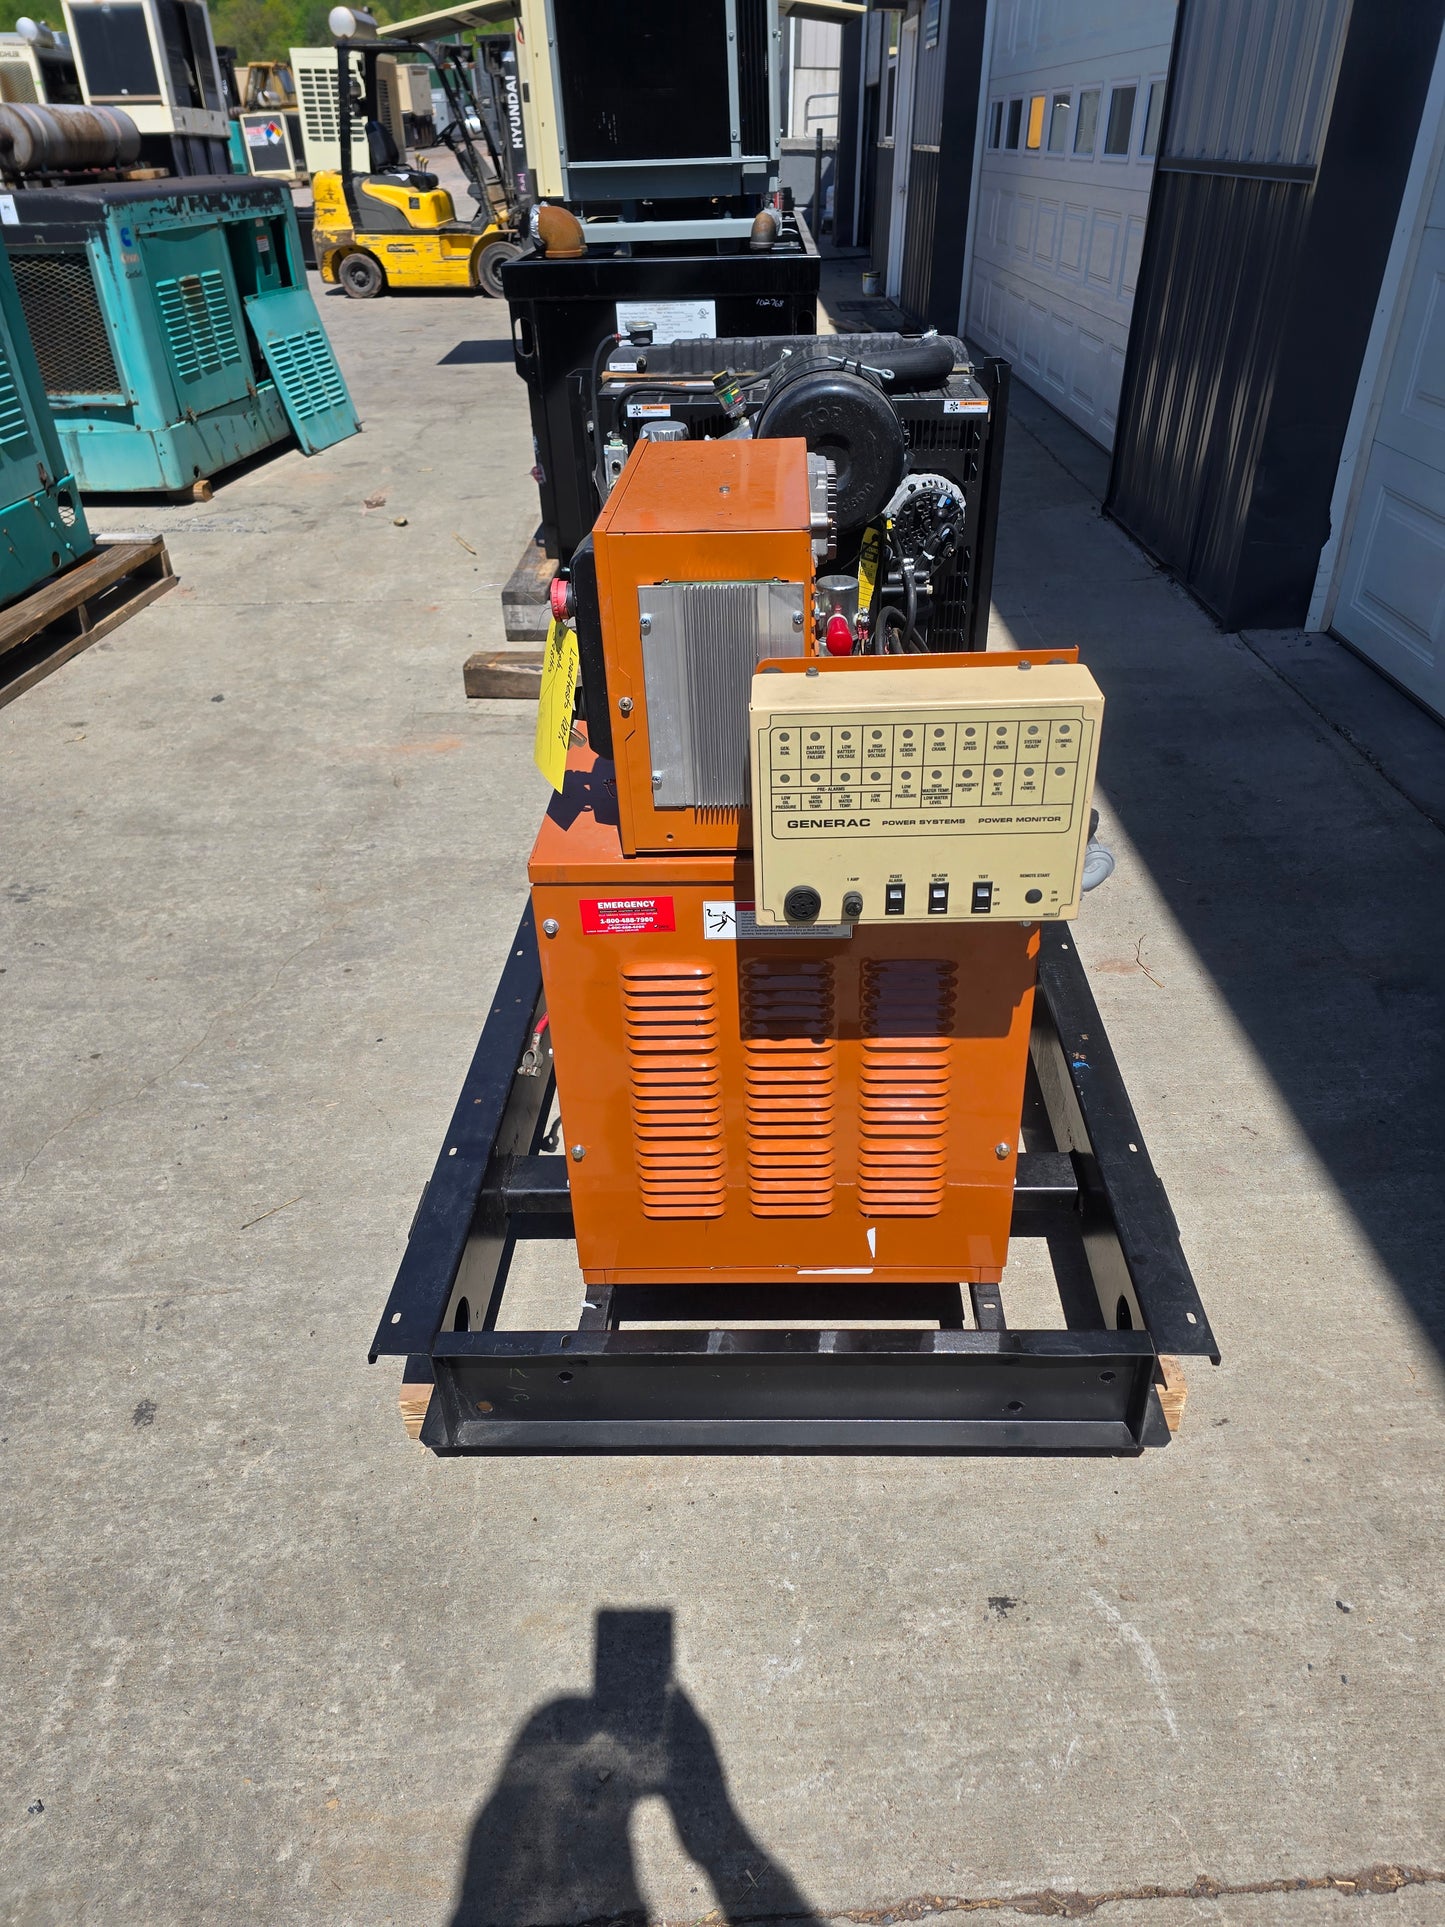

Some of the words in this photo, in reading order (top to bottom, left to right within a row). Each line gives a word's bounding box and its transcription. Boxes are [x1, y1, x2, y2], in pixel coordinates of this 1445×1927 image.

[504, 75, 524, 149] HYUNDAI
[787, 819, 871, 828] GENERAC
[597, 901, 655, 909] EMERGENCY
